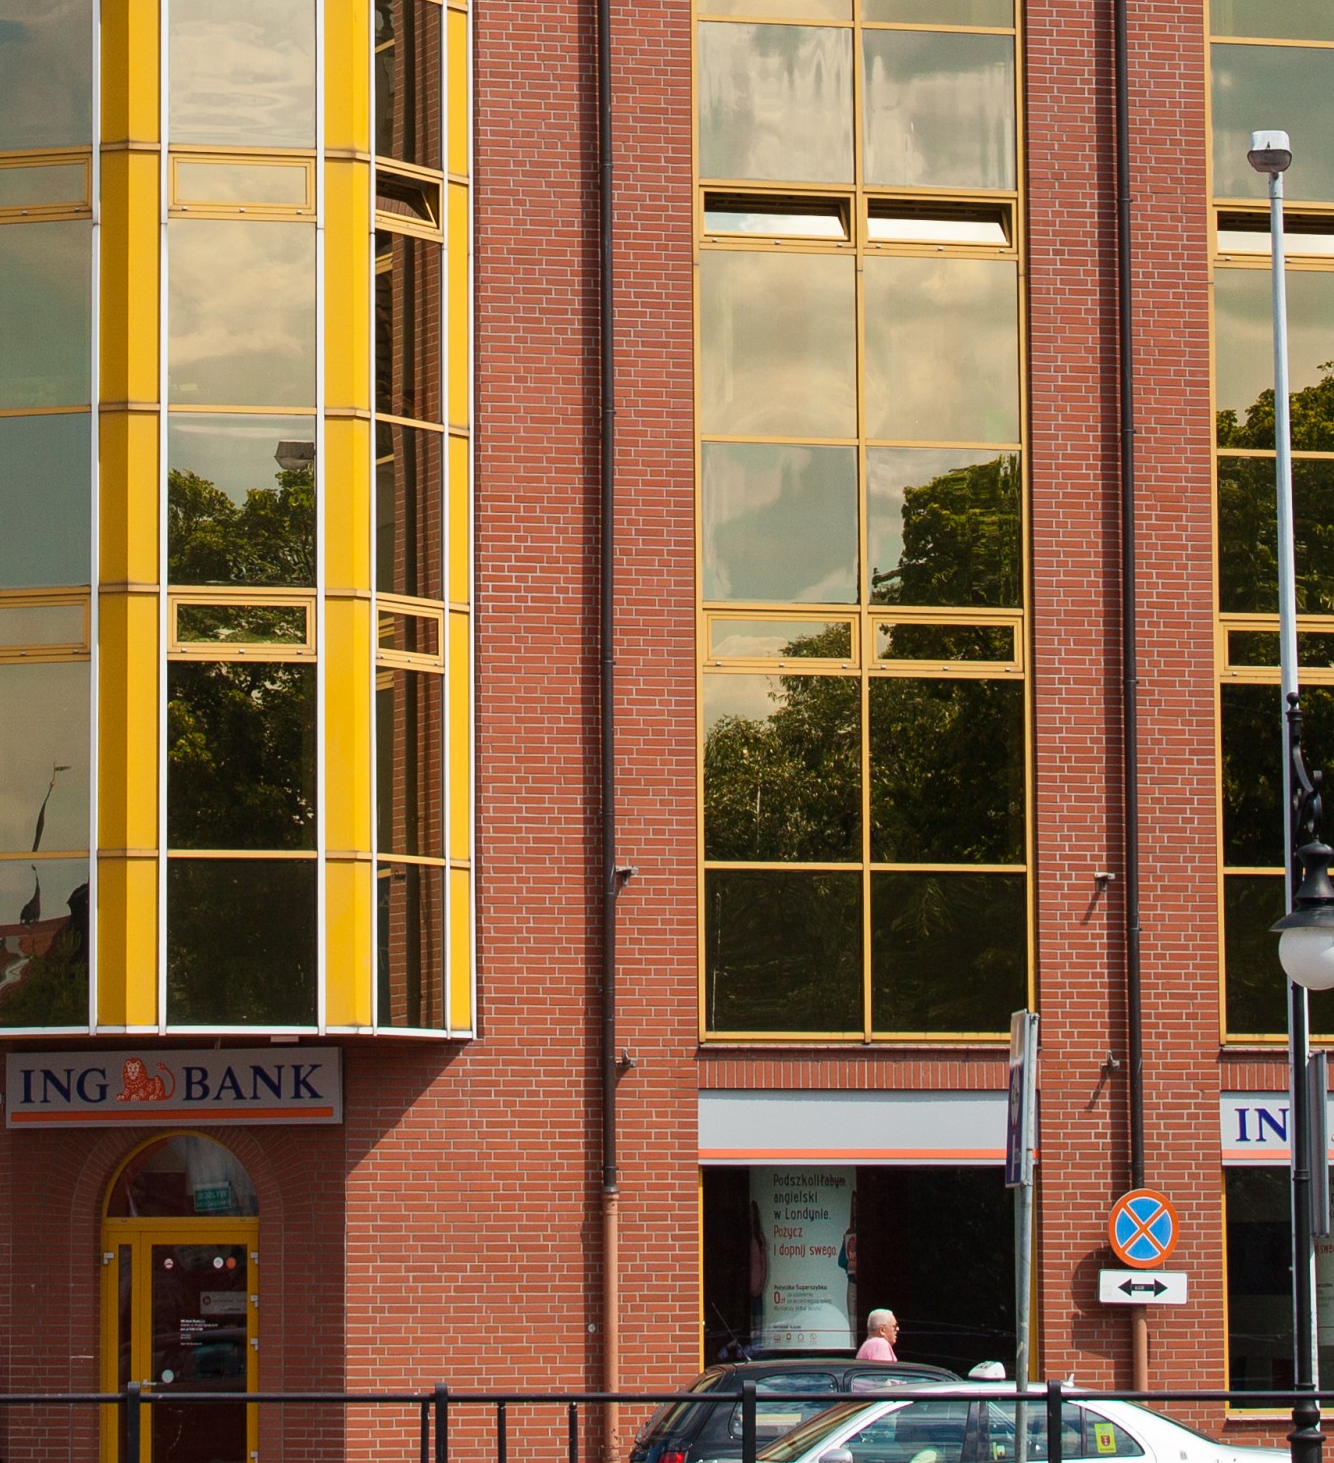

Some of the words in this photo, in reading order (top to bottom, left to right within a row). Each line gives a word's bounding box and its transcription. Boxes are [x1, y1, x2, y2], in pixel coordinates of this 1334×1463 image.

[20, 1068, 110, 1104] ING
[181, 1064, 324, 1101] BANK
[1234, 1108, 1289, 1142] IN
[773, 1190, 818, 1205] angielski
[774, 1210, 781, 1220] w
[773, 1225, 803, 1239] Pożycz
[779, 1243, 806, 1258] dopnij
